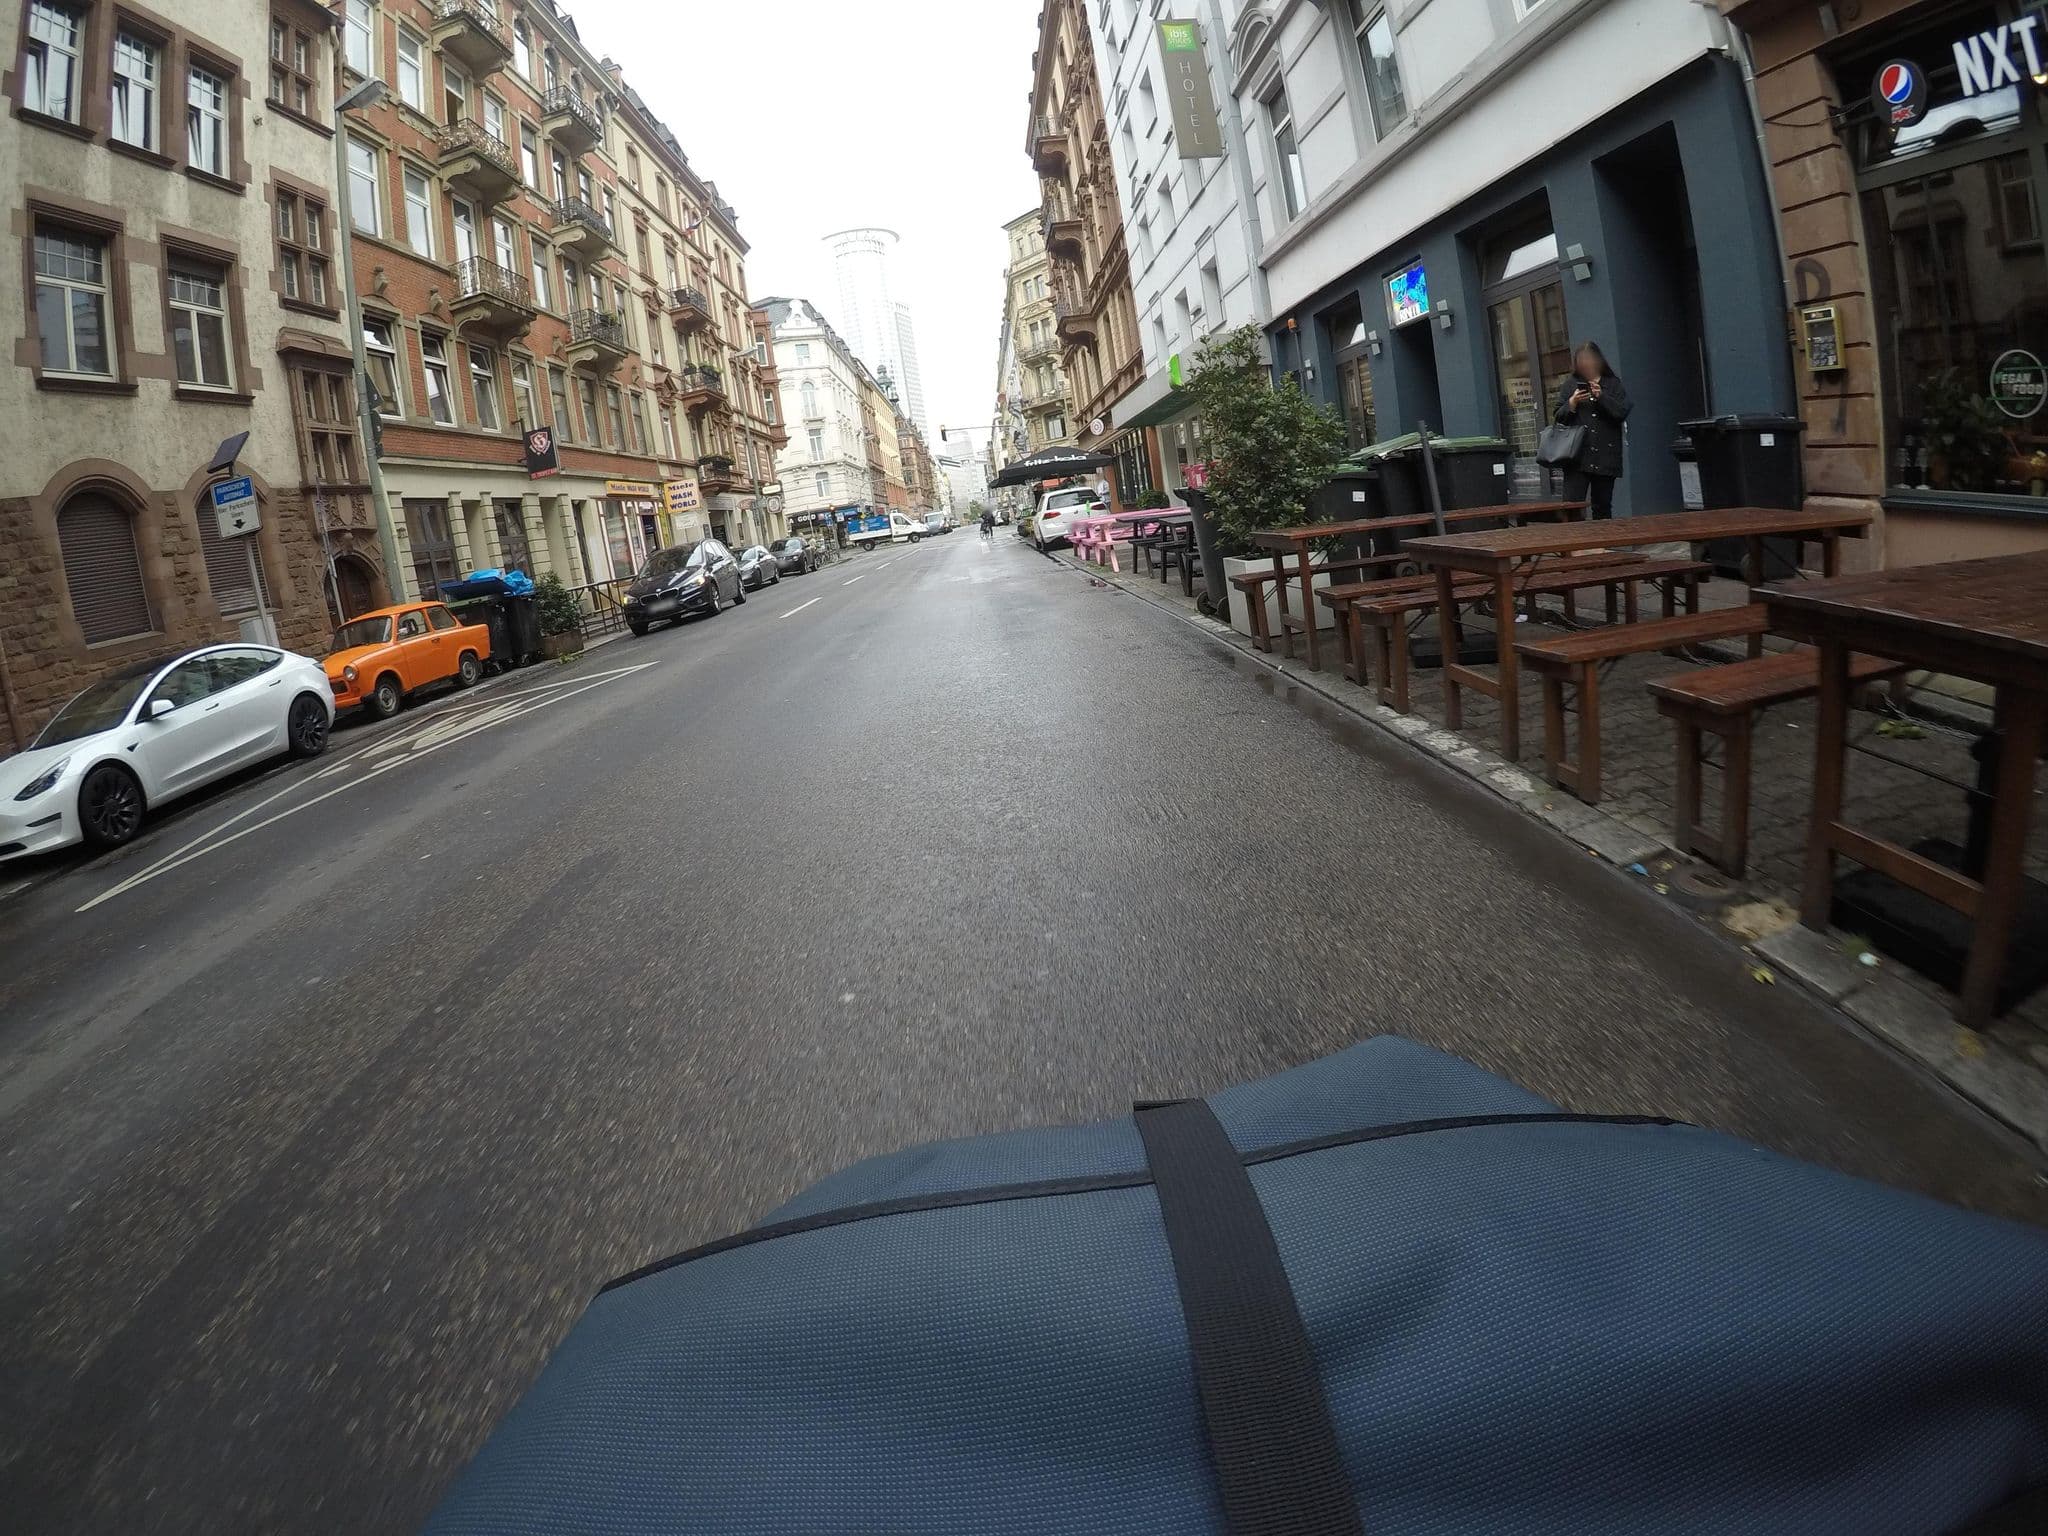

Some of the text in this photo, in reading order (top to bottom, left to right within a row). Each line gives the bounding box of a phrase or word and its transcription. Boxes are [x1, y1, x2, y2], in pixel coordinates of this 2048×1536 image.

[1170, 29, 1188, 39] ibis
[1952, 15, 2042, 97] NXT
[1179, 61, 1204, 146] HOTEL
[1995, 371, 2032, 385] VEGAN
[2012, 383, 2043, 396] FOOD
[1023, 454, 1087, 467] fritz-kola
[668, 482, 694, 491] Miele
[670, 490, 694, 501] WASH
[669, 499, 697, 511] WORLD
[797, 513, 816, 523] GOLD
